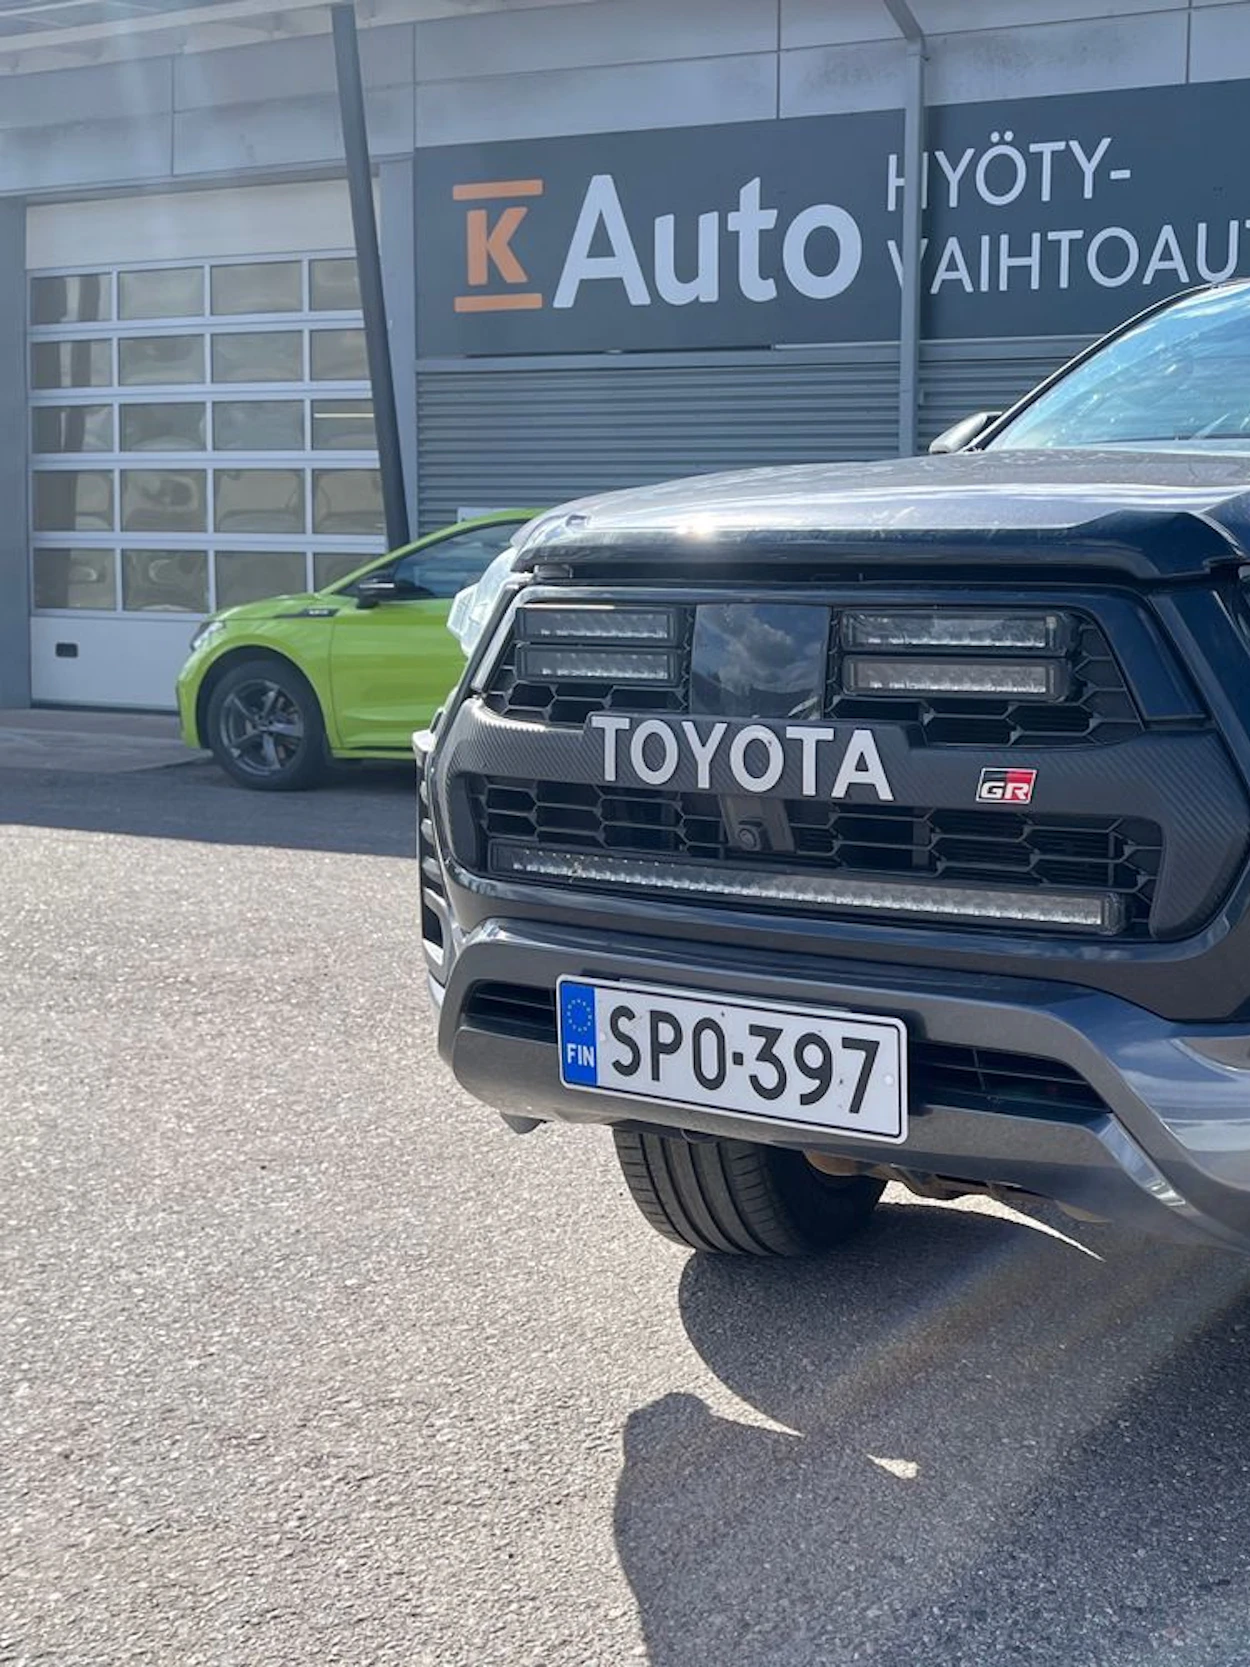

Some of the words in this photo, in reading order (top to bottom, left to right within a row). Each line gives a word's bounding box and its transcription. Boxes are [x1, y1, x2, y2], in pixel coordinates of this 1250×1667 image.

[886, 129, 1132, 212] HYÖTY-
[462, 201, 532, 290] K
[552, 173, 863, 309] Auto
[590, 715, 895, 802] TOYOTA
[980, 780, 1031, 801] GR
[566, 1042, 596, 1069] FIN
